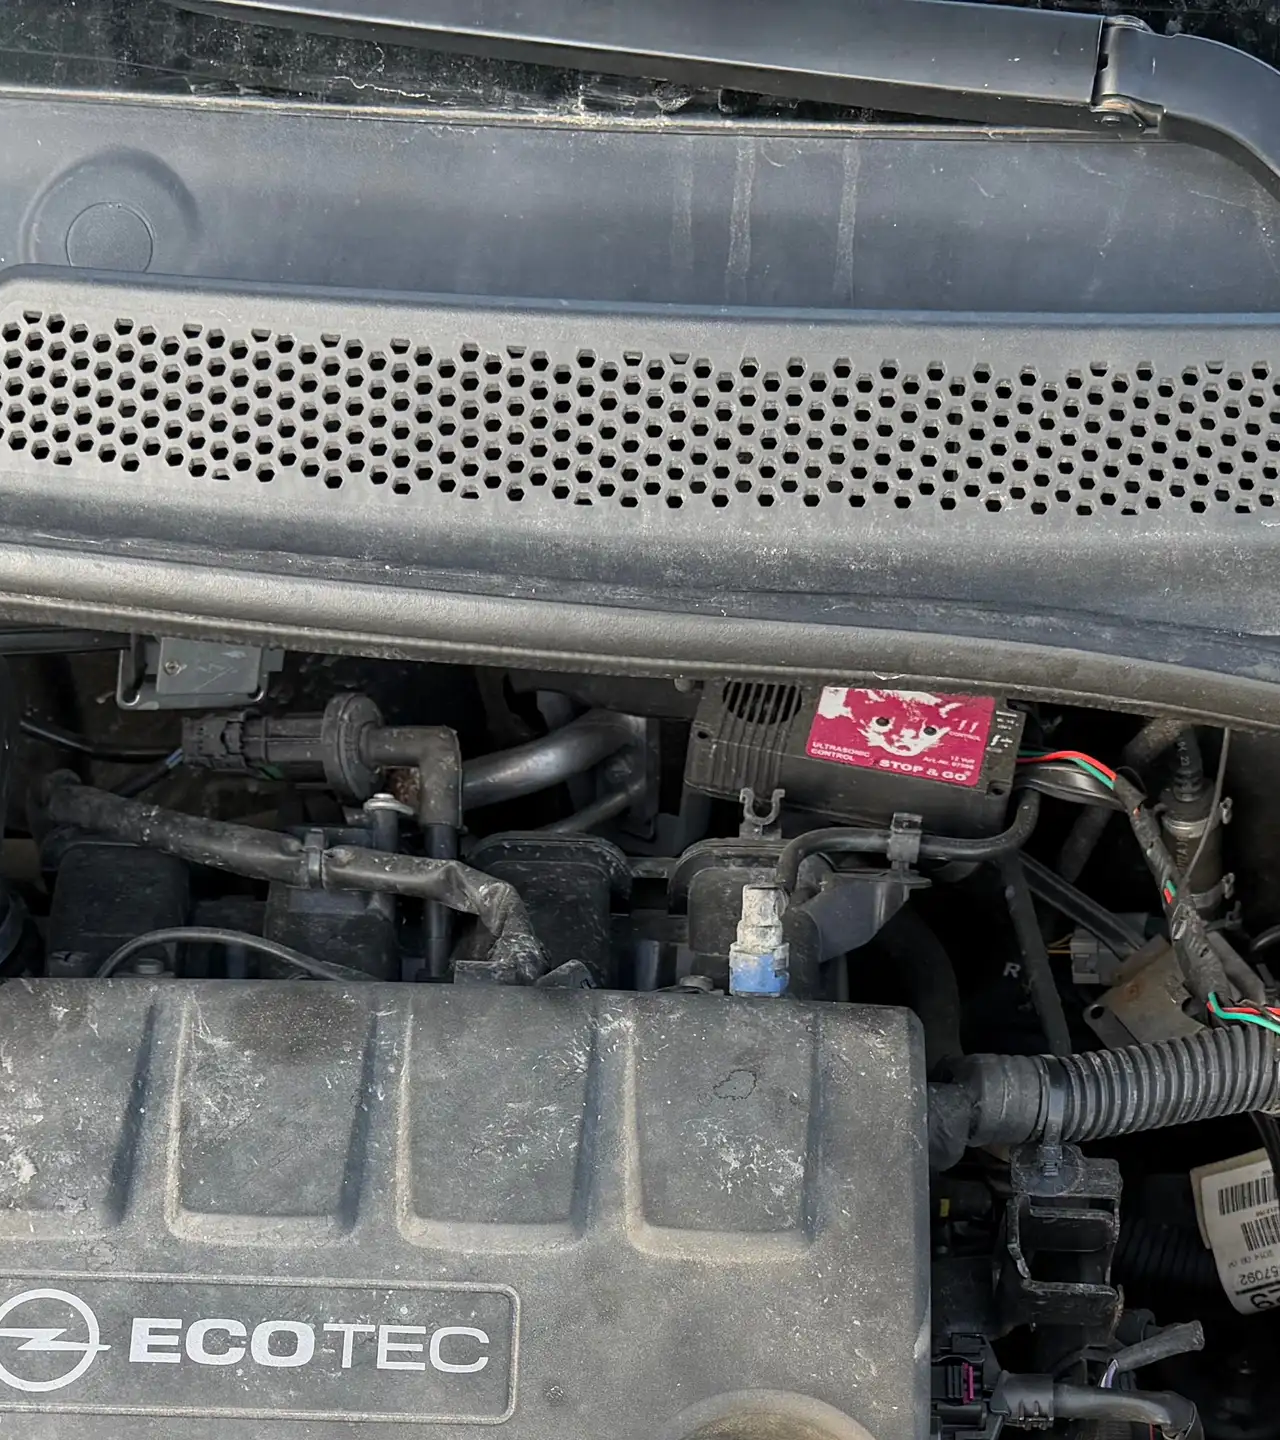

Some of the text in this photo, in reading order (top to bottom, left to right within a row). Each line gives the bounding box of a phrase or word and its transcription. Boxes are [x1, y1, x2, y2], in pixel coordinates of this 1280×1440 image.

[811, 748, 855, 761] CONTROL
[812, 741, 870, 757] ULTRASONIC
[879, 759, 924, 772] STOP
[926, 768, 938, 777] &
[129, 1318, 490, 1373] ECOTEC
